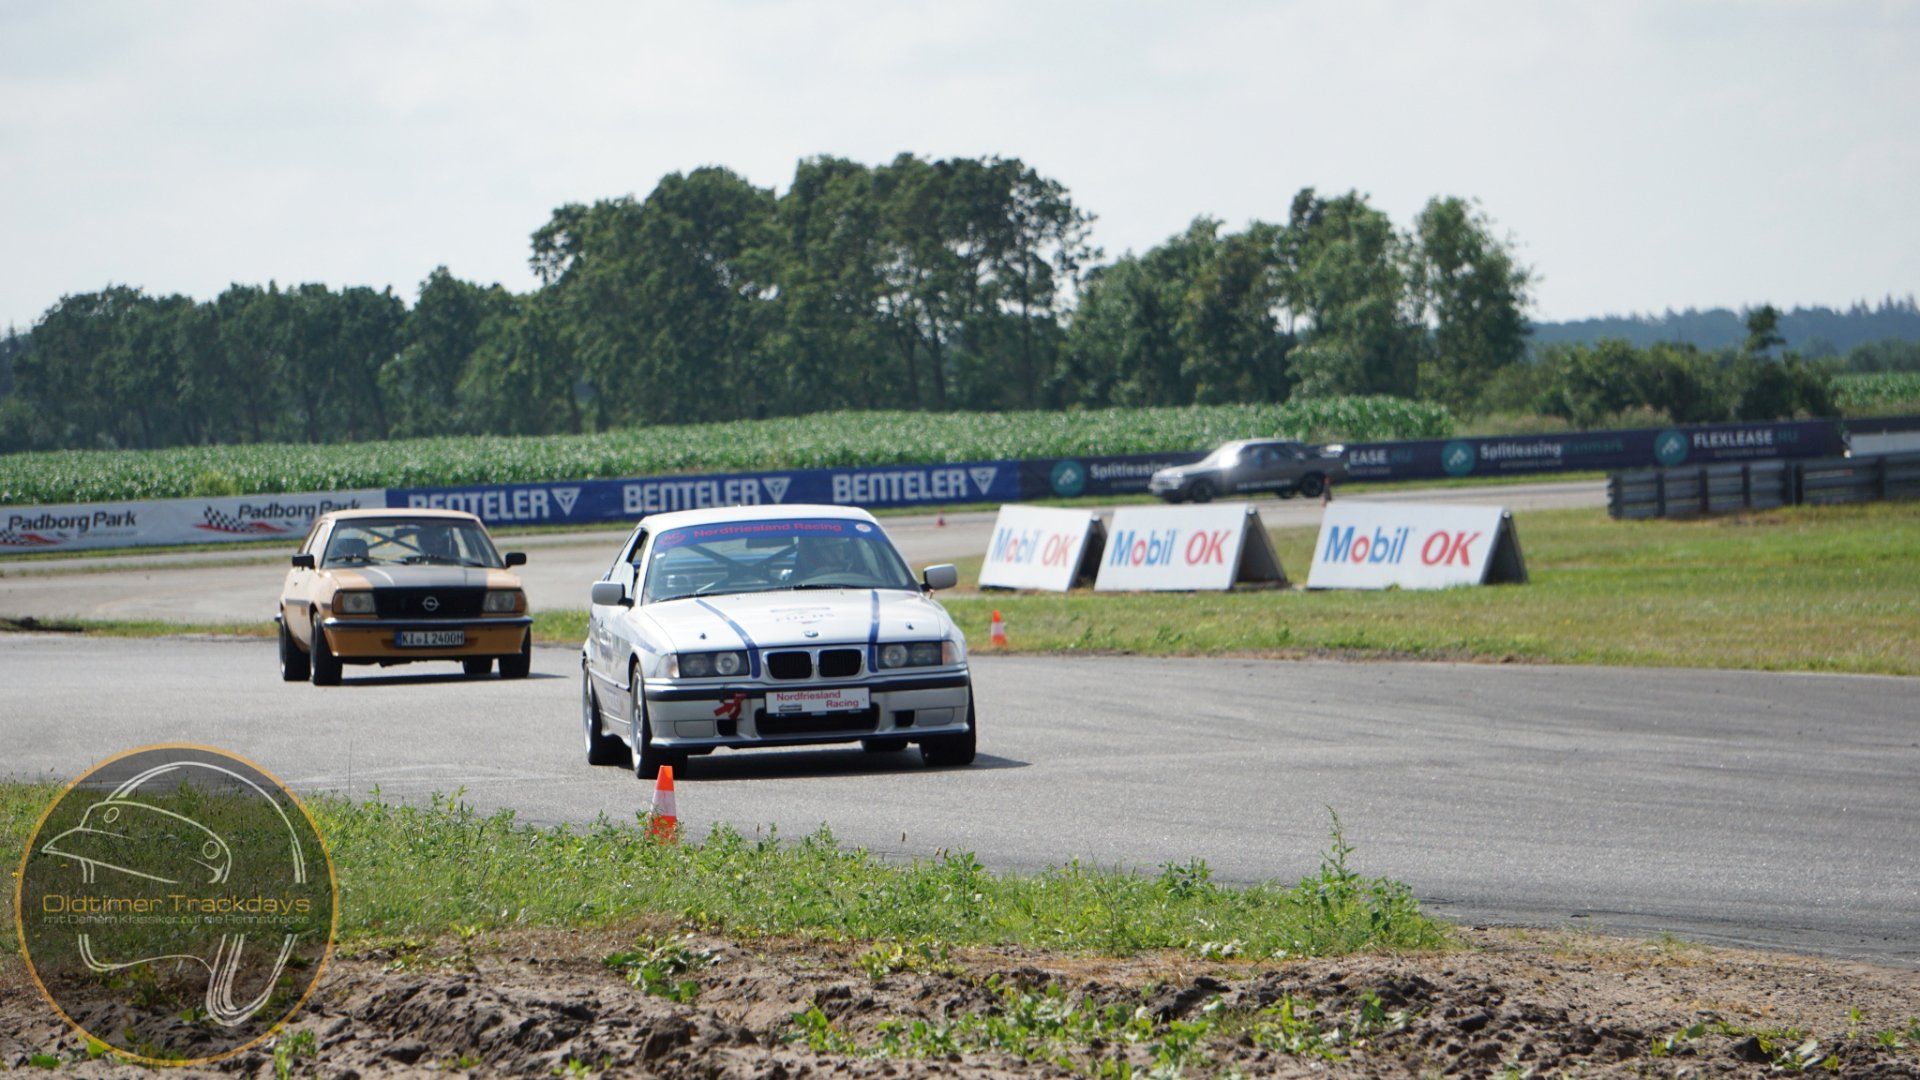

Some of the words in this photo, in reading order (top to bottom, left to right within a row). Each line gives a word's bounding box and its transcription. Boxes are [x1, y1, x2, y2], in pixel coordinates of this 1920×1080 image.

[1480, 441, 1562, 460] Splitleasing
[623, 478, 760, 513] BENTELER
[833, 469, 968, 503] BENTELER
[8, 513, 90, 532] Padborg
[93, 510, 137, 528] Park
[238, 501, 316, 520] Padborg
[693, 522, 791, 539] Nordfriesland
[794, 521, 842, 532] Racing
[990, 528, 1041, 564] Mobil
[1042, 534, 1078, 567] OK
[1109, 528, 1177, 567] Mobil
[1185, 530, 1232, 566] OK
[1323, 526, 1409, 564] Mobil
[1420, 531, 1483, 567] OK
[776, 689, 841, 701] Nordfriesland
[826, 699, 859, 708] Racing
